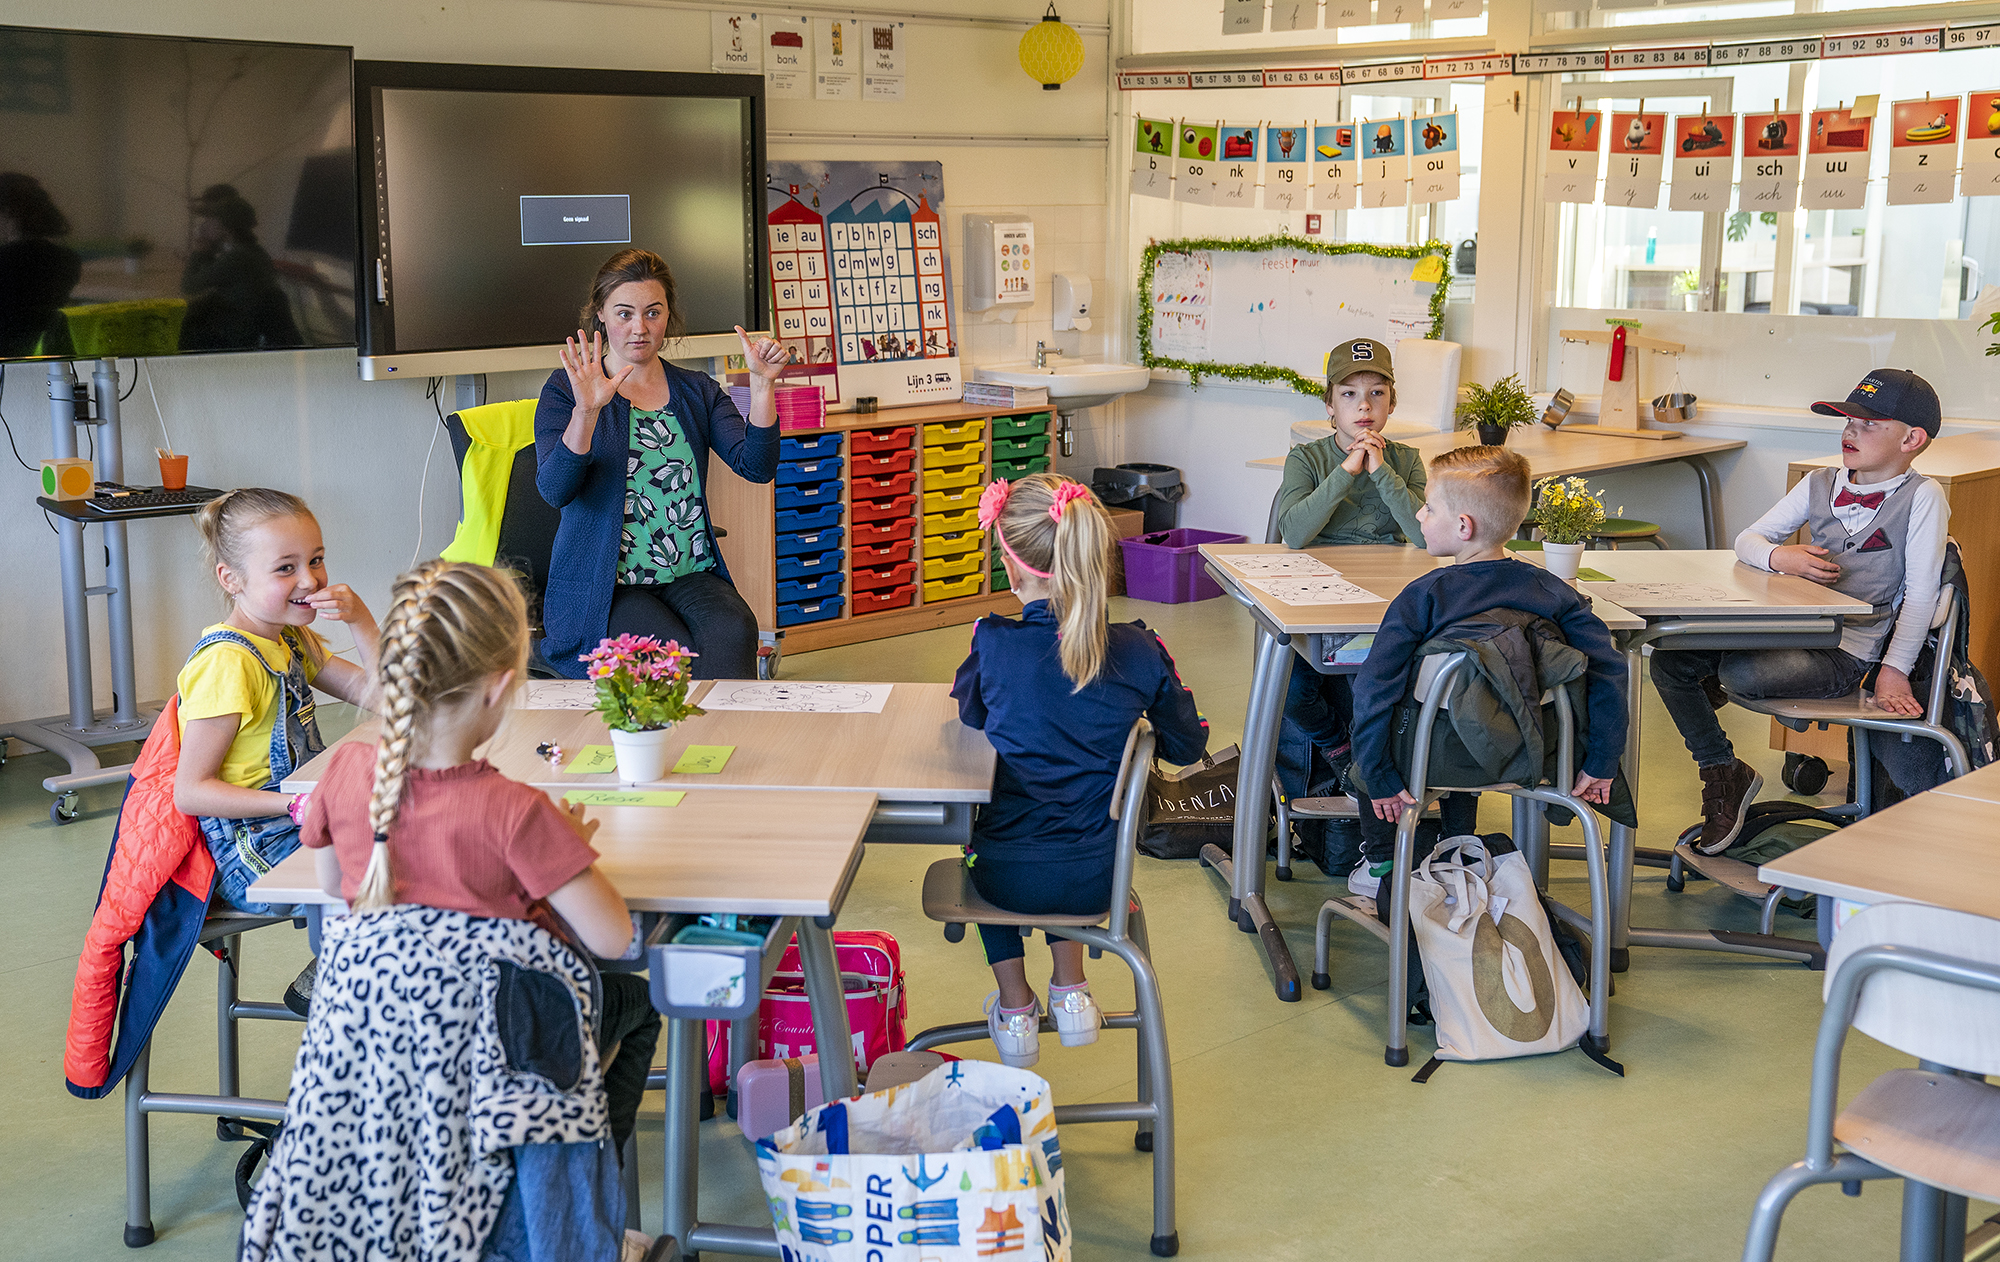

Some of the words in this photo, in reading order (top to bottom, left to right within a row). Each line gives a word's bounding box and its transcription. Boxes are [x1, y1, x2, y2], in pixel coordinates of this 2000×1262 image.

[726, 51, 748, 62] hond
[777, 54, 798, 64] bank
[831, 57, 843, 67] vla
[1123, 77, 1131, 85] 51
[1137, 77, 1145, 85] 52
[1150, 77, 1158, 85] 53
[1177, 76, 1186, 84] 55
[1209, 75, 1217, 83] 57
[1223, 75, 1231, 83] 58
[1252, 74, 1260, 82] 60
[1269, 74, 1277, 82] 61
[1284, 73, 1292, 82] 62
[1299, 73, 1308, 81] 63
[1314, 73, 1323, 81] 64
[1330, 72, 1339, 80] 65
[1346, 70, 1356, 79] 66
[1362, 69, 1371, 78] 67
[1378, 68, 1387, 77] 68
[1394, 66, 1404, 75] 69
[1411, 65, 1420, 74] 70
[1430, 65, 1438, 73] 71
[1447, 63, 1456, 72] 72
[1464, 62, 1474, 71] 73
[1482, 61, 1492, 69] 74
[1499, 59, 1510, 68] 75
[1520, 59, 1530, 68] 76
[1539, 58, 1548, 67] 77
[1557, 57, 1567, 66] 78
[1576, 56, 1586, 65] 79
[1594, 55, 1605, 65] 80
[1614, 55, 1624, 64] 81
[1633, 54, 1645, 63] 82
[1653, 53, 1665, 62] 83
[1673, 52, 1685, 62] 84
[1694, 51, 1706, 61] 85
[1716, 50, 1728, 59] 86
[1737, 48, 1749, 58] 87
[1759, 46, 1771, 57] 88
[1781, 45, 1793, 55] 89
[1803, 43, 1816, 54] 90
[1829, 41, 1841, 51] 91
[1852, 40, 1866, 50] 92
[1876, 38, 1889, 48] 93
[1900, 36, 1913, 47] 94
[1925, 35, 1938, 45] 95
[1951, 32, 1965, 43] 96
[1976, 30, 1990, 41] 97
[1150, 156, 1157, 170] b
[1427, 160, 1443, 171] ou
[1569, 159, 1577, 169] v
[1630, 158, 1639, 177] ij
[1757, 159, 1783, 176] sch
[1826, 161, 1847, 173] uu
[1918, 154, 1928, 166] z
[1189, 166, 1203, 176] oo
[1230, 164, 1244, 178] nk
[1278, 169, 1293, 183] ng
[1328, 164, 1341, 178] ch
[1381, 161, 1386, 179] j
[1695, 161, 1710, 176] ui
[777, 228, 789, 243] ie
[801, 231, 816, 242] au
[837, 230, 842, 240] r
[851, 226, 860, 241] b
[867, 226, 875, 240] h
[883, 229, 891, 243] p
[917, 225, 937, 240] sch
[776, 260, 793, 271] oe
[808, 256, 816, 275] ij
[838, 254, 846, 269] d
[853, 259, 864, 270] m
[869, 257, 880, 267] w
[886, 255, 894, 270] g
[923, 252, 937, 267] ch
[783, 284, 795, 299] ei
[809, 284, 820, 299] ui
[840, 282, 849, 297] k
[858, 284, 865, 297] t
[874, 281, 880, 297] f
[890, 284, 896, 294] z
[925, 283, 940, 297] ng
[844, 314, 852, 324] n
[876, 314, 883, 324] v
[893, 308, 898, 326] j
[928, 305, 942, 320] nk
[784, 318, 800, 329] eu
[810, 317, 826, 327] ou
[847, 342, 853, 352] s
[1352, 342, 1373, 361] S
[907, 375, 924, 389] Lijn
[926, 374, 932, 384] 3
